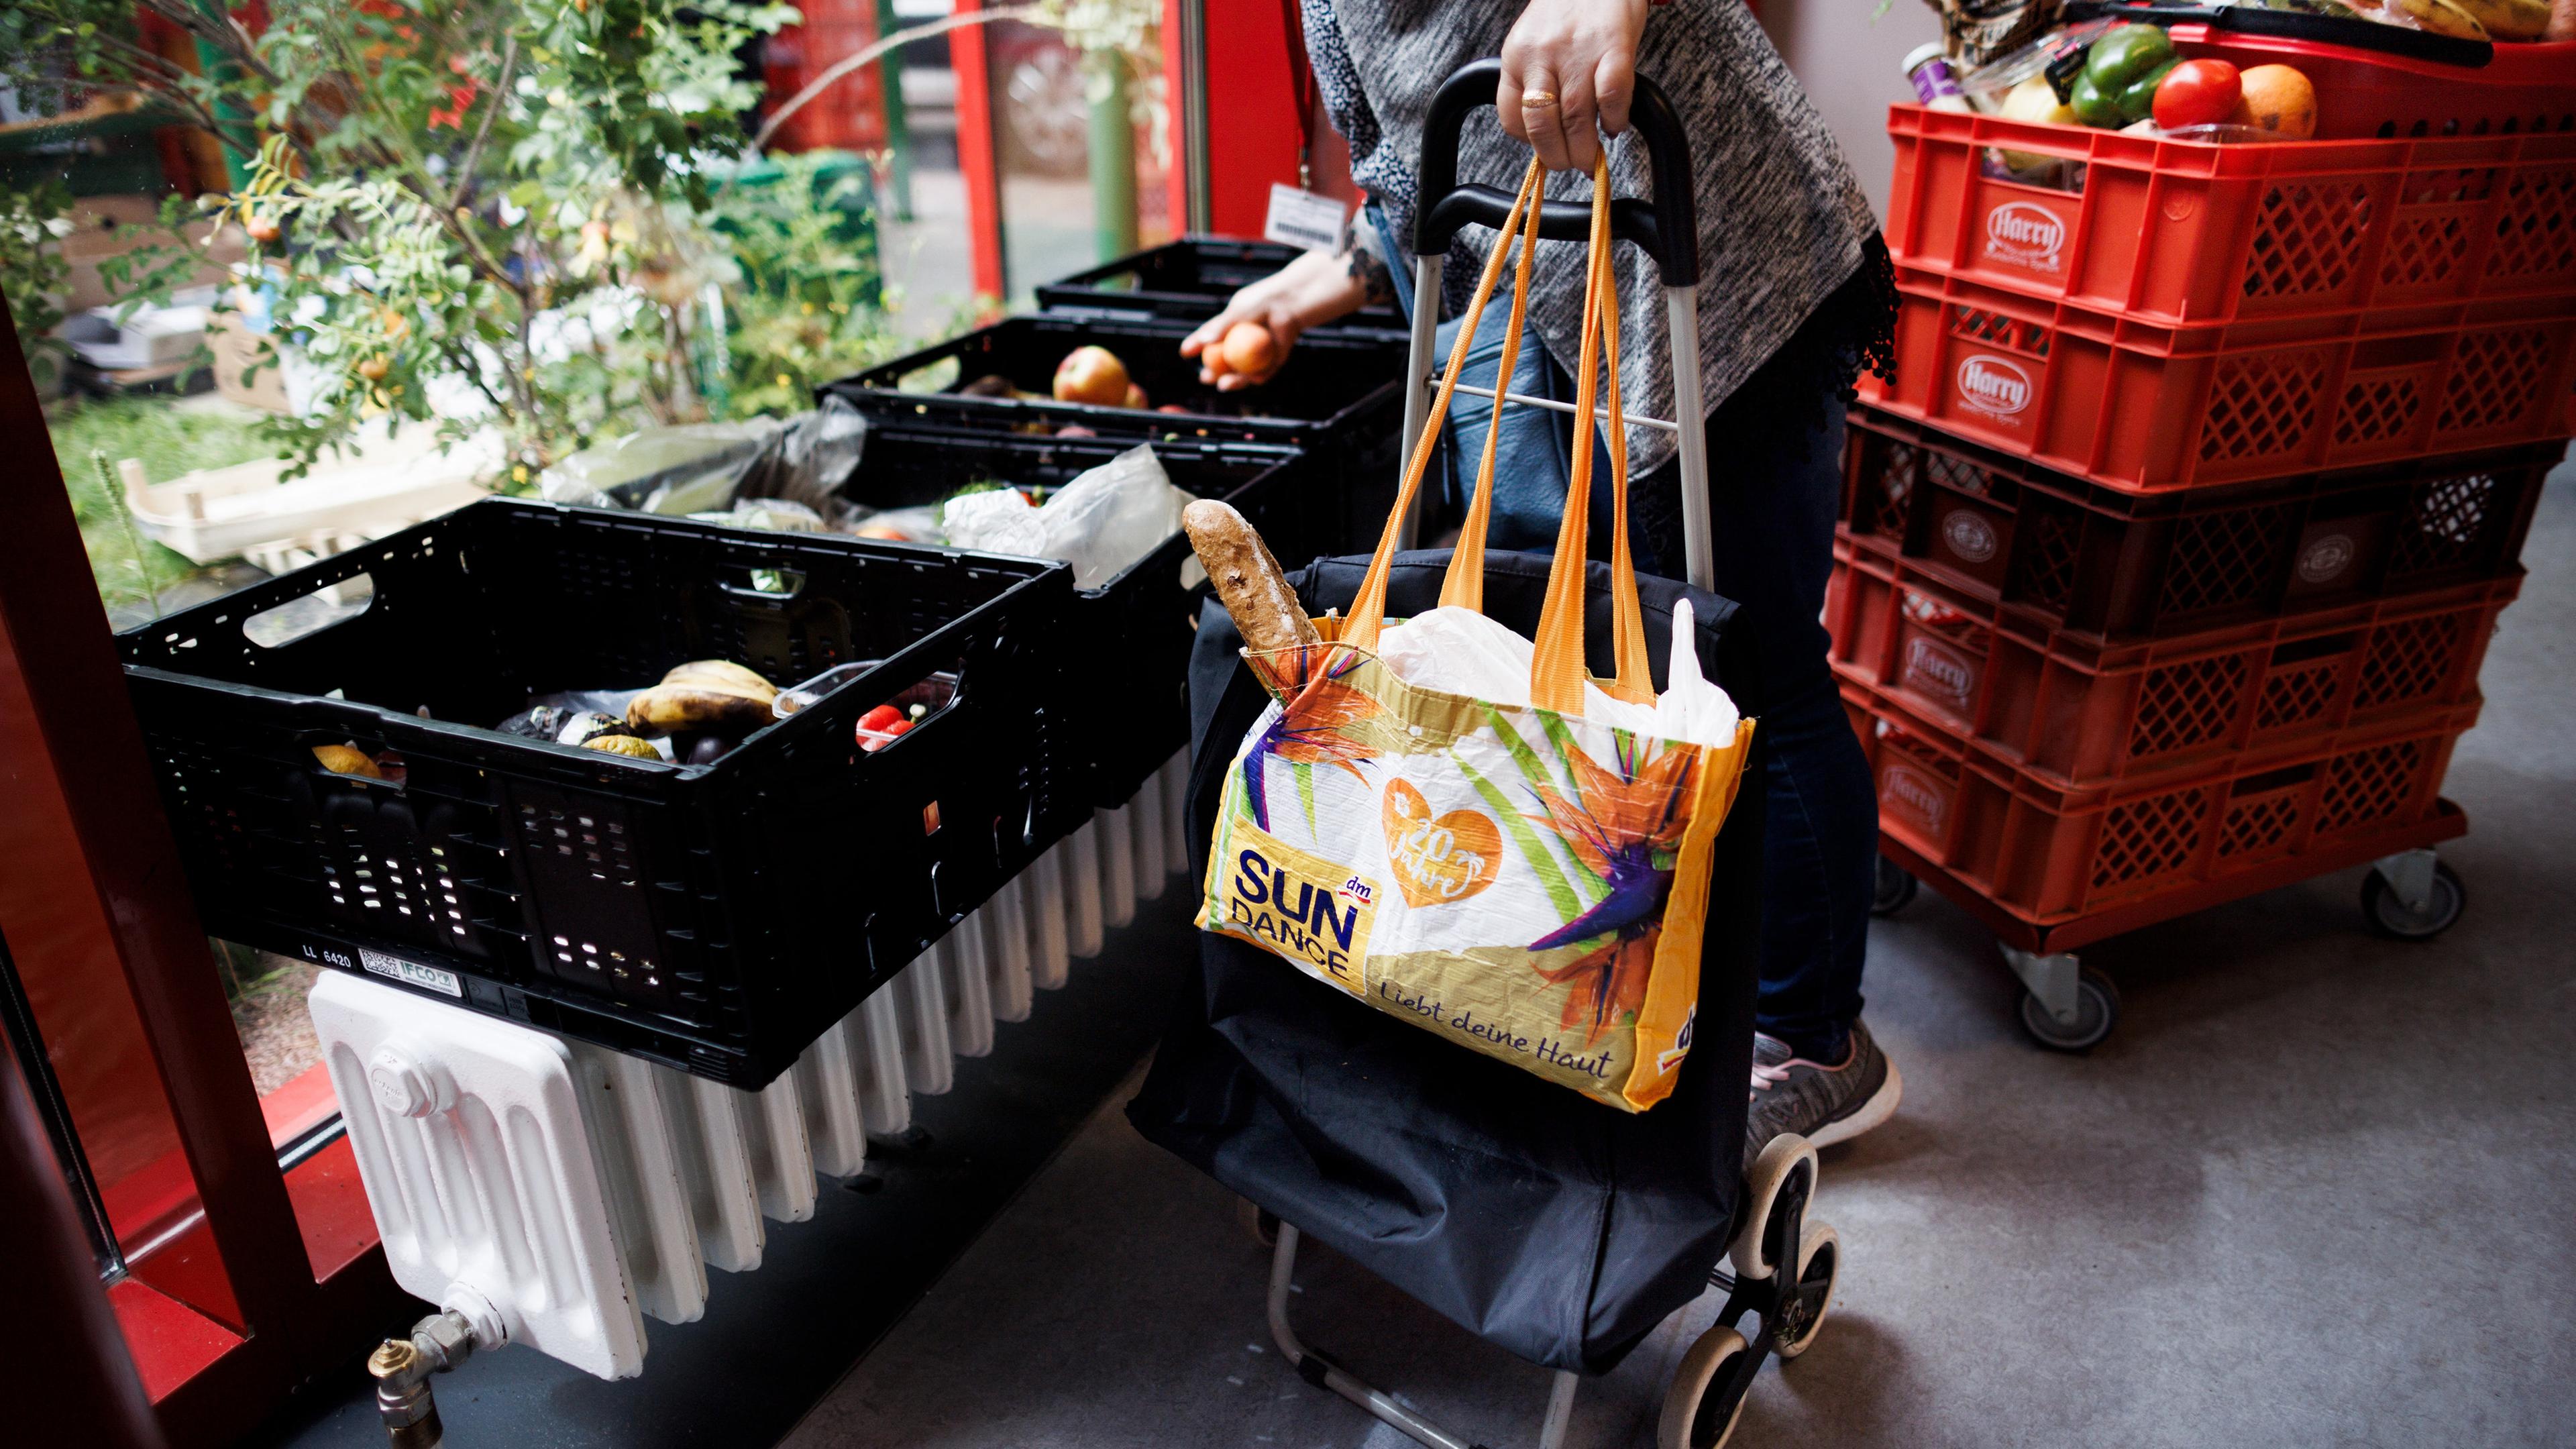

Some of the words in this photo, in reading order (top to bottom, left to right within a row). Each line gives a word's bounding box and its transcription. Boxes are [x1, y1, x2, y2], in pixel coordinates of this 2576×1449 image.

[1995, 209, 2057, 251] Harry
[1965, 362, 2025, 407] Harry
[1408, 818, 1454, 861] 20
[1389, 831, 1461, 897] Jahre
[1235, 849, 1358, 953] SUN
[1346, 876, 1372, 898] dm
[303, 945, 317, 958] LL
[323, 951, 352, 967] 6420
[1232, 896, 1350, 981] DANCE
[400, 961, 436, 981] IFCO
[1381, 981, 1445, 1022] Liebt
[1452, 1011, 1529, 1053] deine
[1536, 1037, 1613, 1079] Haut
